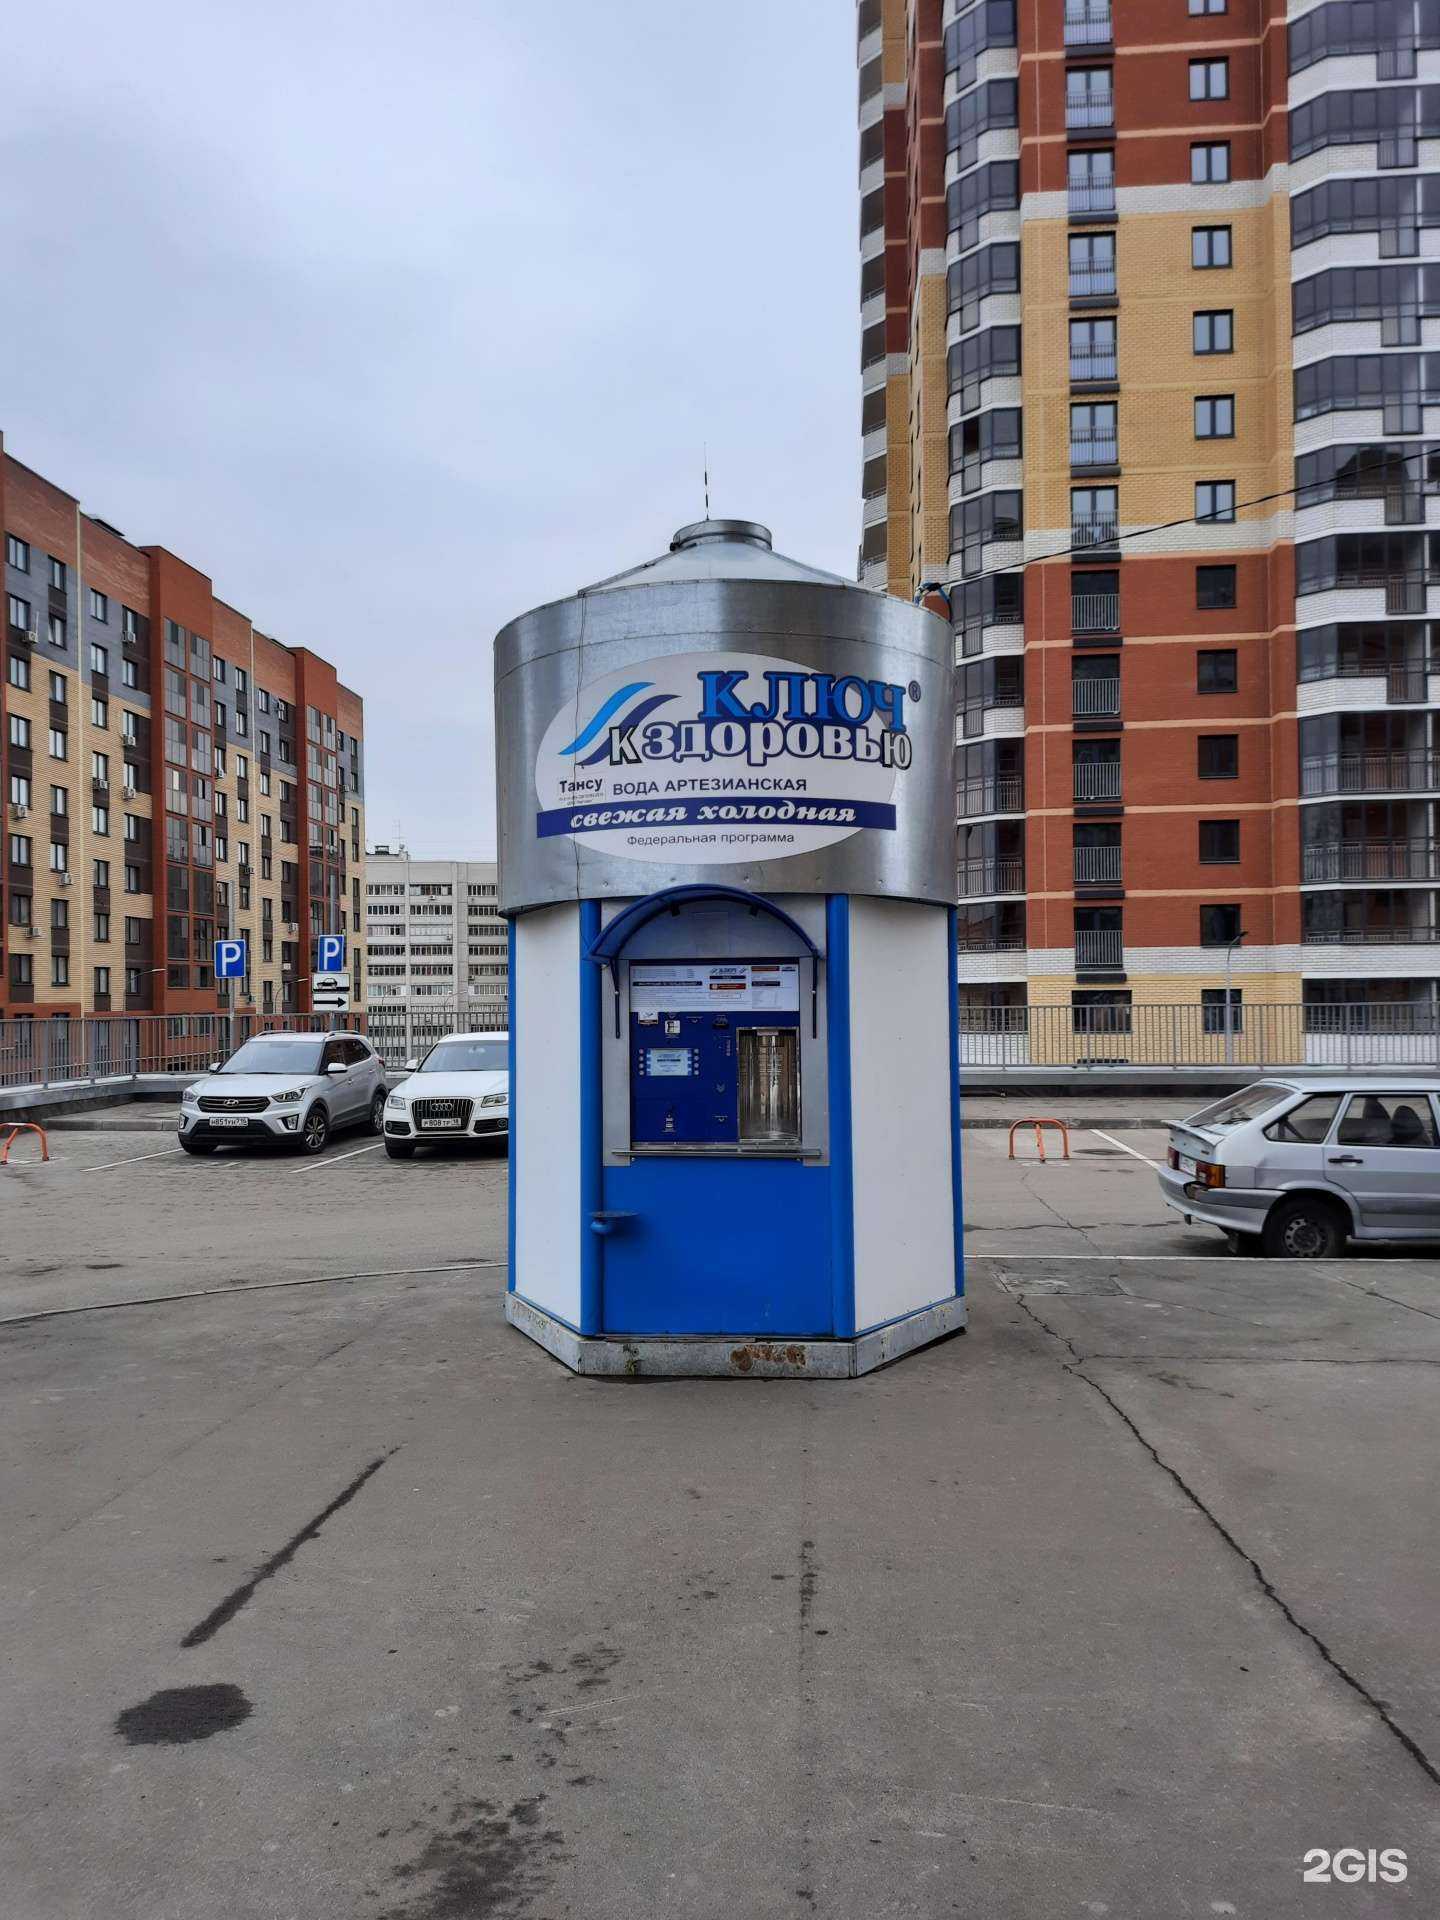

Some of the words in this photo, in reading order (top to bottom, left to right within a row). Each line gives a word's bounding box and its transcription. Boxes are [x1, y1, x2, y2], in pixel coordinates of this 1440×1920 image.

[559, 778, 603, 793] Тансу
[613, 782, 659, 796] ВОДА
[665, 778, 807, 793] АРТЕЗИАНСКАЯ
[570, 803, 688, 829] свежая
[697, 800, 857, 822] холодная
[627, 833, 715, 847] Федеральная
[721, 832, 795, 845] программа
